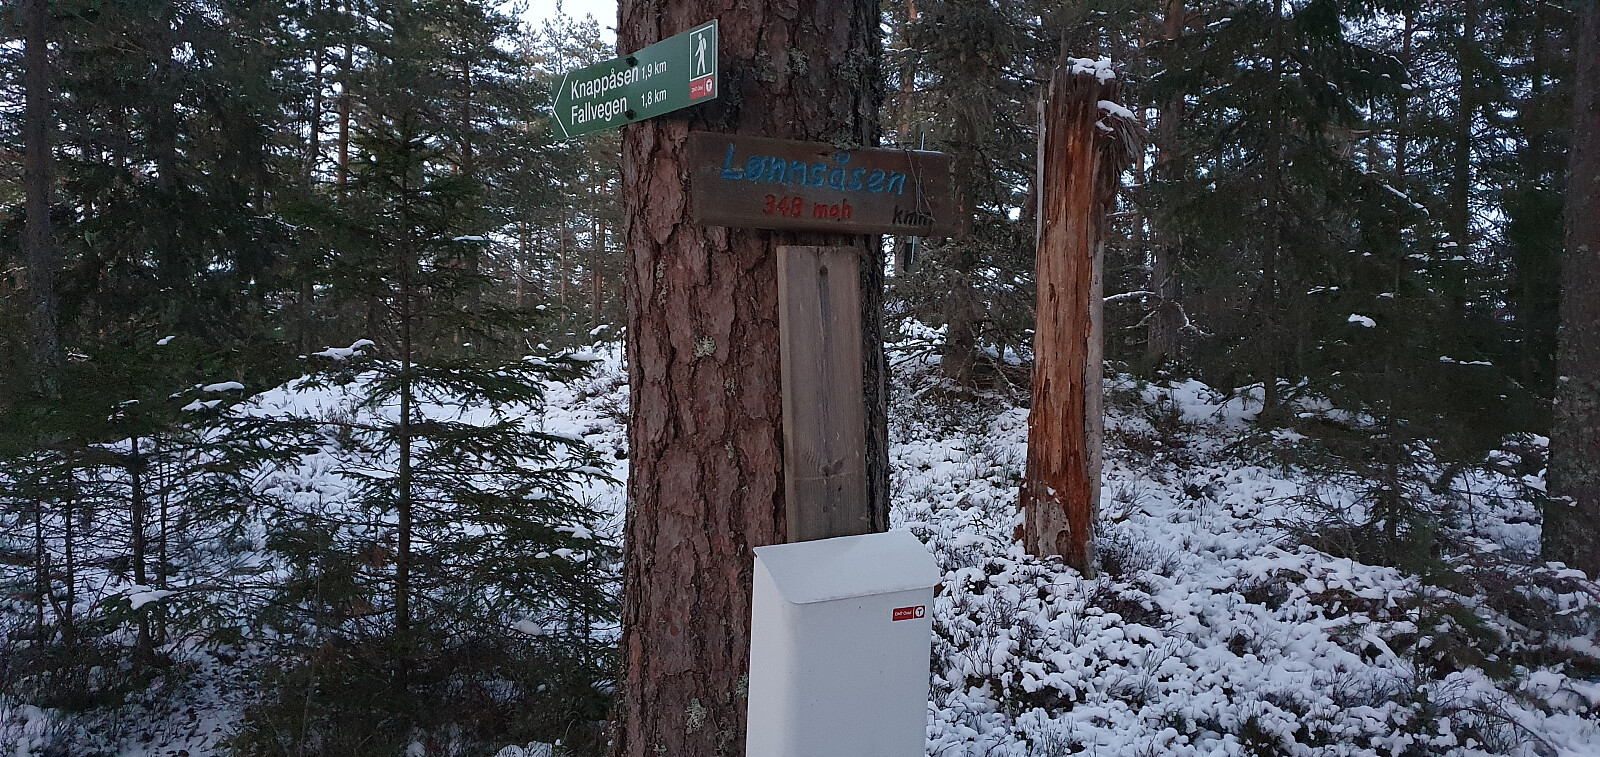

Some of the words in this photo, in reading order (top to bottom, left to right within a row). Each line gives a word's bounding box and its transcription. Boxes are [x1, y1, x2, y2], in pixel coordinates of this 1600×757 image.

[571, 66, 639, 100] Knappåsen
[641, 66, 653, 80] 1,9
[655, 60, 667, 74] km
[571, 96, 627, 125] Fallvegen
[640, 91, 653, 108] 1,8
[655, 88, 667, 102] km
[721, 143, 907, 195] Lønnsåsen
[762, 194, 804, 218] 348
[812, 198, 853, 218] moh
